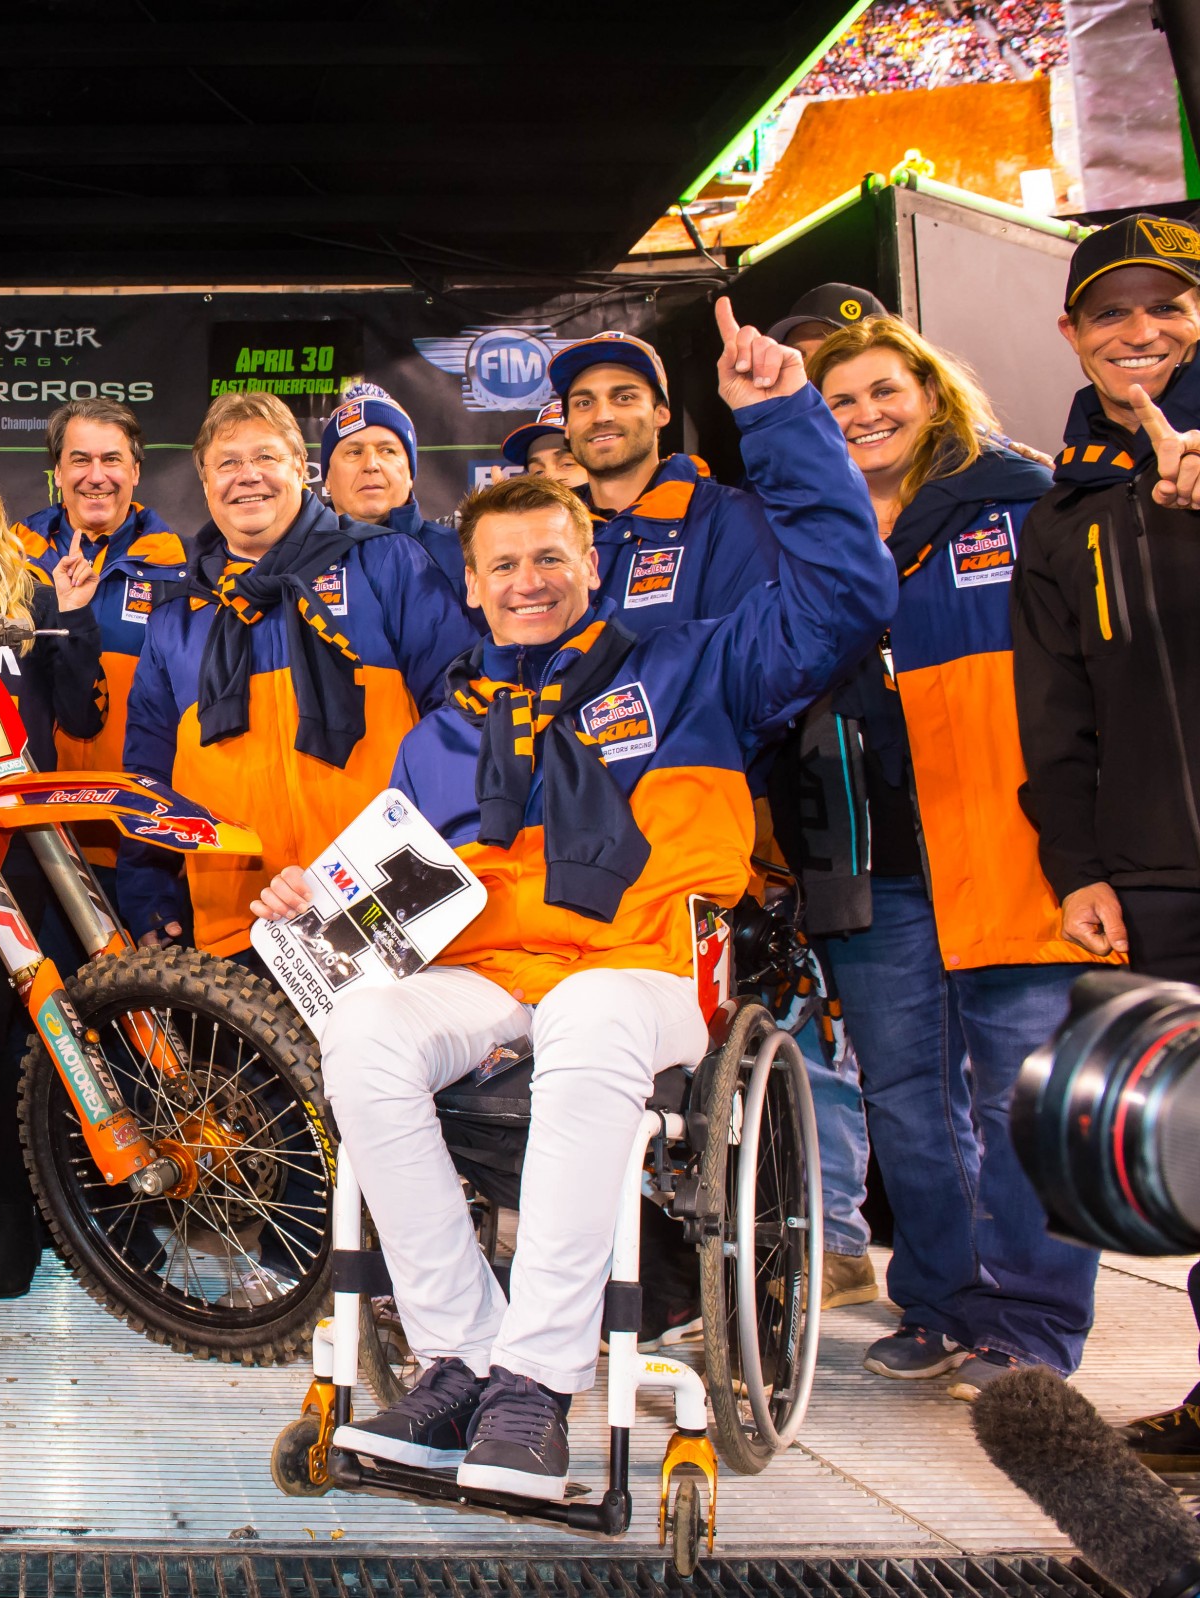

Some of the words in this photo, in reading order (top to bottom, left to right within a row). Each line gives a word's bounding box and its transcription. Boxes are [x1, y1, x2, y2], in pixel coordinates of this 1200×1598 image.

[235, 347, 294, 373] APRIL
[301, 346, 334, 372] 30
[480, 349, 542, 383] FIM
[210, 379, 245, 397] EAST
[1, 417, 48, 432] Champion
[956, 540, 981, 554] Red
[982, 533, 1008, 550] Bull
[633, 565, 653, 577] Red
[653, 563, 675, 574] Bull
[960, 551, 1010, 571] KTM
[631, 576, 671, 593] KTM
[590, 710, 616, 730] Red
[616, 700, 644, 719] Bull
[597, 719, 648, 744] KTM
[604, 746, 628, 756] ACTORY
[47, 791, 80, 803] Red
[80, 789, 120, 803] Bull
[323, 860, 360, 901] AMA
[264, 918, 295, 959] WORLD
[292, 957, 334, 1015] SUPERCR
[273, 955, 319, 1018] CHAMPION
[55, 1034, 108, 1119] MOTOREX
[302, 1099, 337, 1188] DUNL
